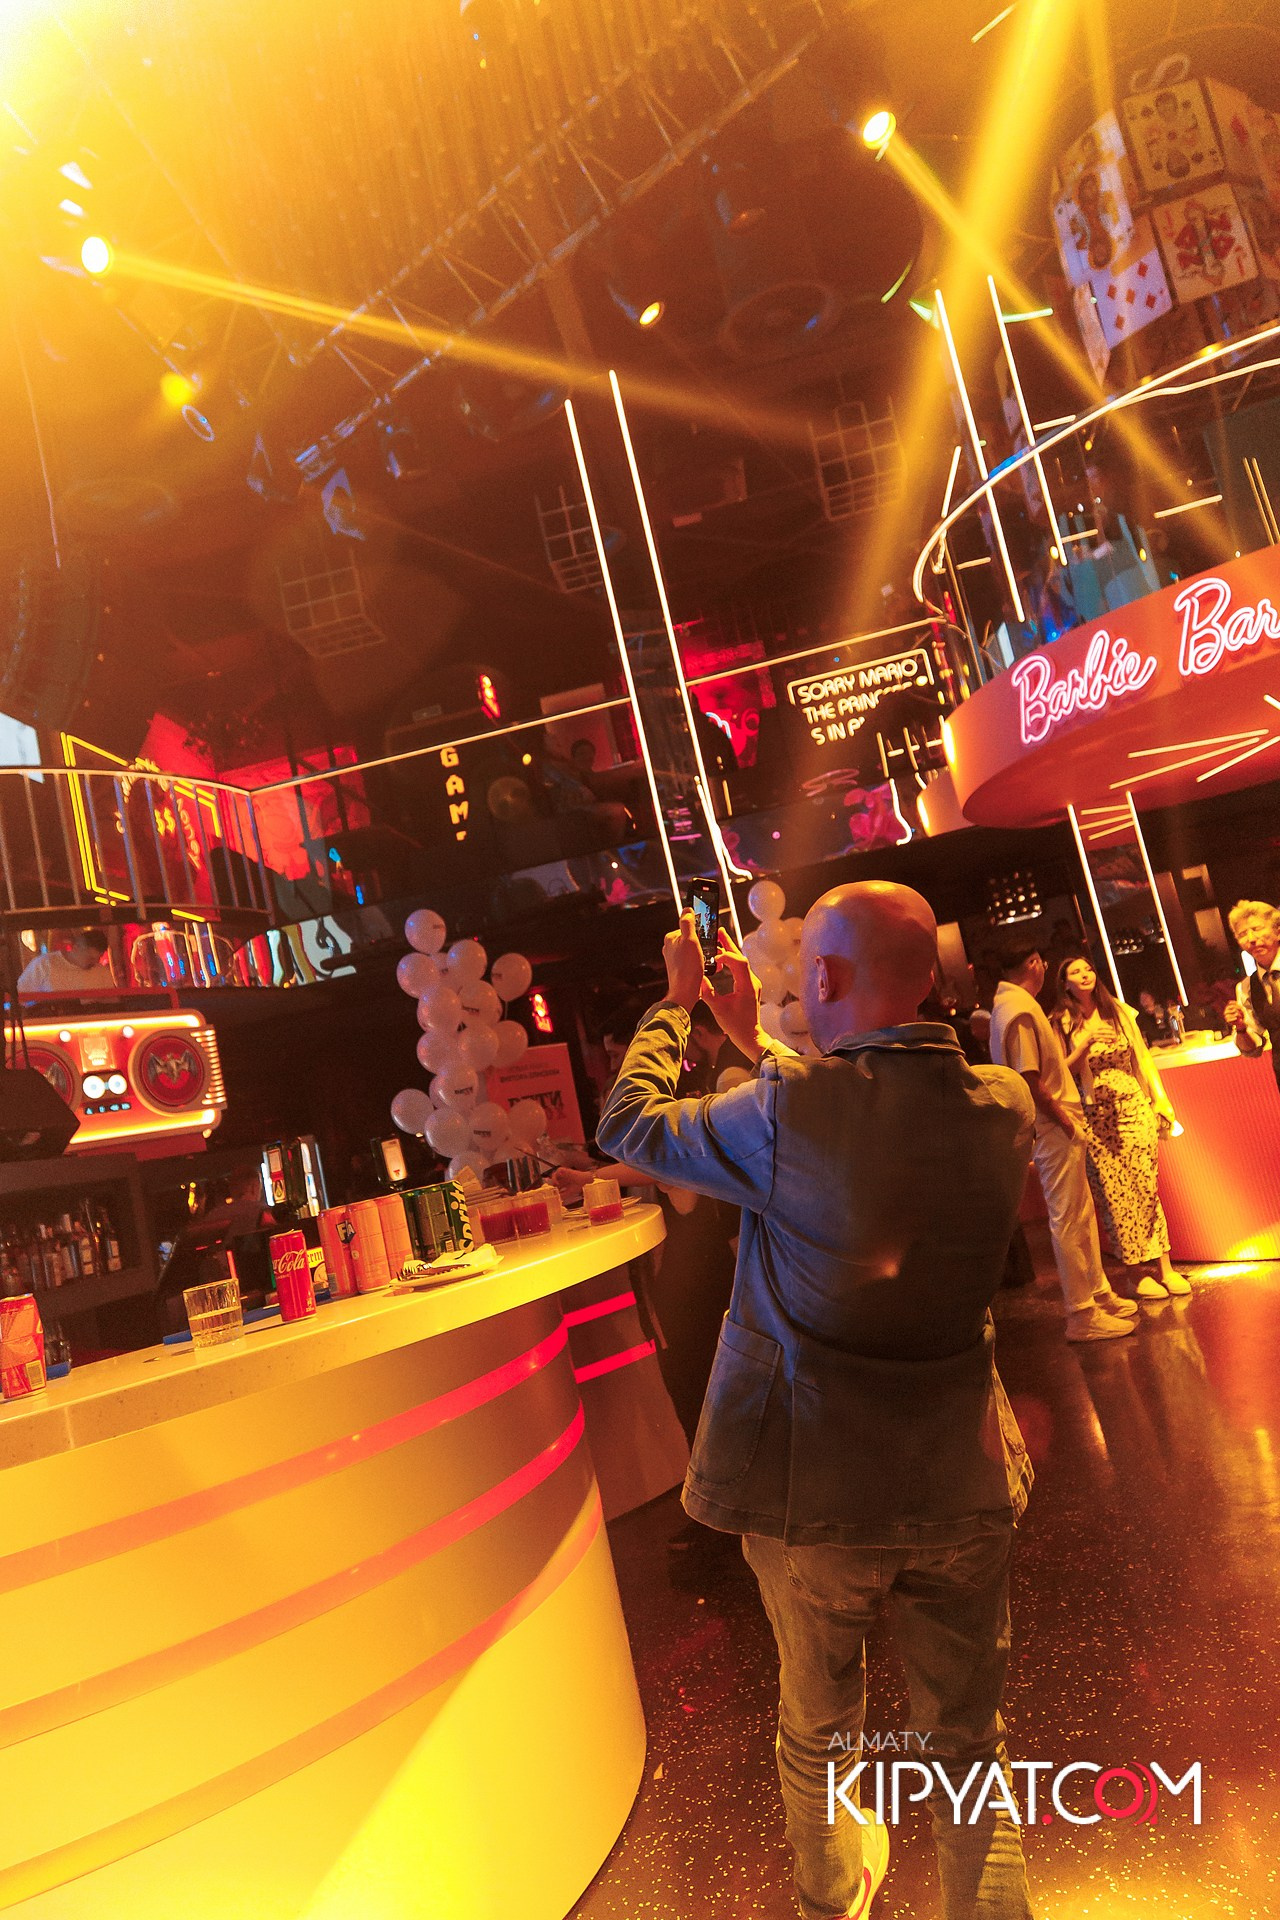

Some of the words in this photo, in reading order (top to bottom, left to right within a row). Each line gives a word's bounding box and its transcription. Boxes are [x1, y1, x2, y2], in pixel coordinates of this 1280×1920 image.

[797, 673, 856, 705] SORRY
[858, 658, 919, 689] MARIO
[1012, 629, 1158, 744] Barbie
[802, 701, 837, 725] THE
[826, 721, 847, 742] IN
